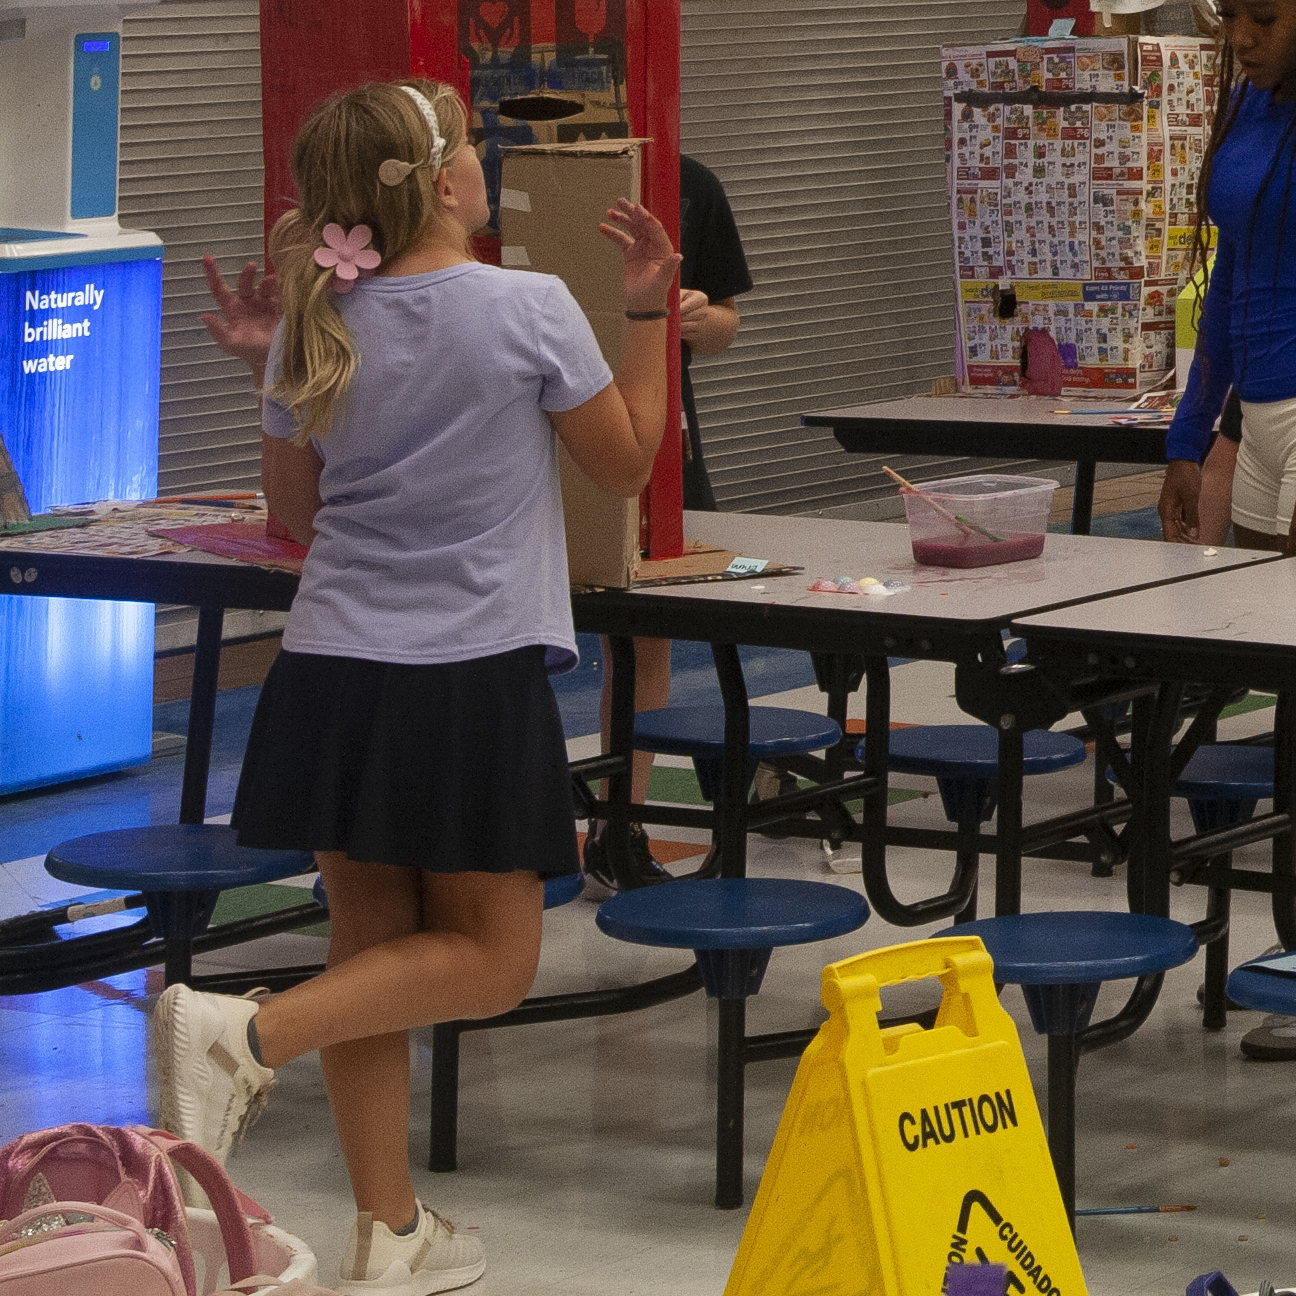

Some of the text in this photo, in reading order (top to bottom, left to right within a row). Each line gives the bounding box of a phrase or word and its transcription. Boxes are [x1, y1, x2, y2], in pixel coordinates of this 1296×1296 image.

[25, 283, 105, 311] Naturally
[24, 318, 91, 343] brilliant
[22, 354, 75, 375] water
[898, 1088, 1018, 1152] CAUTION
[998, 1221, 1061, 1296] CUIDADO
